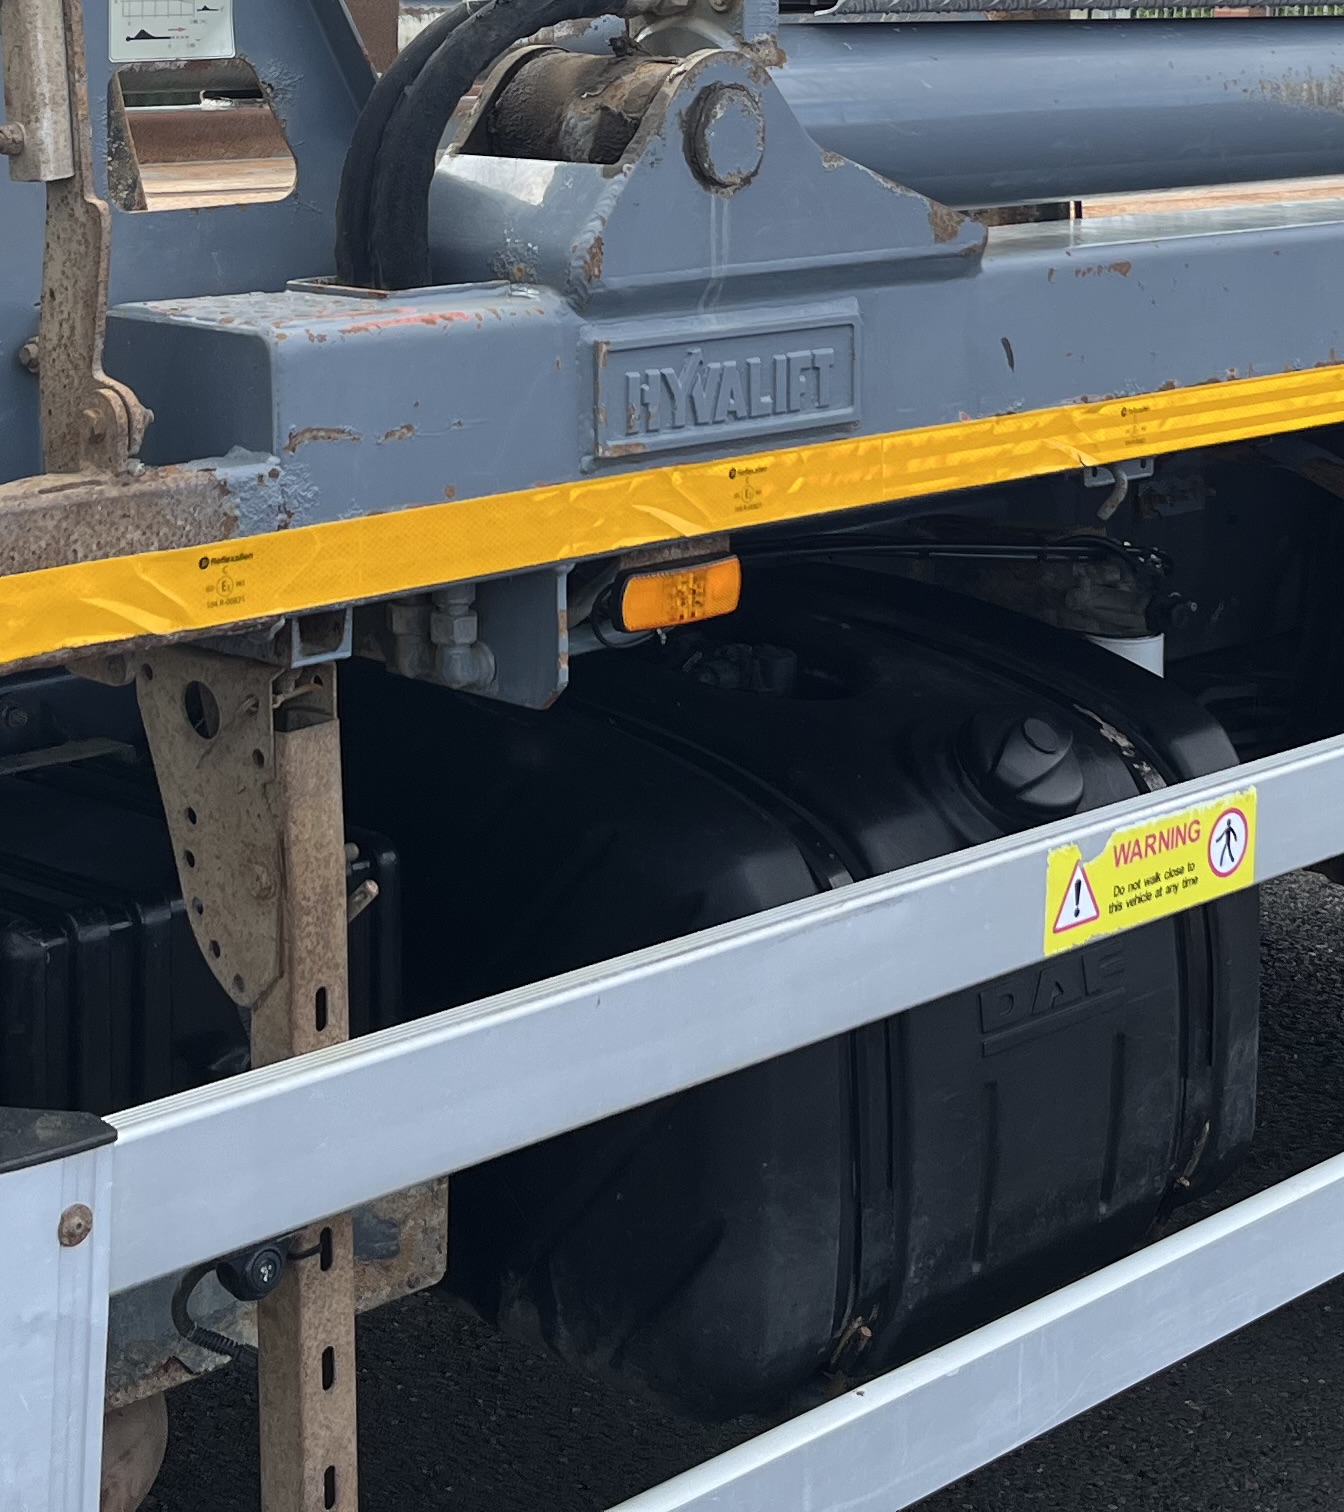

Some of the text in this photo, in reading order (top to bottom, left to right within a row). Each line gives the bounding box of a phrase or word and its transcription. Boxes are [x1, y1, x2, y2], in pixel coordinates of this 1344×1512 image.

[625, 347, 835, 436] HYVALIFT
[1114, 819, 1201, 867] WARNING
[1110, 876, 1198, 913] this vehicle at any time
[1114, 862, 1195, 897] Do not walk close to
